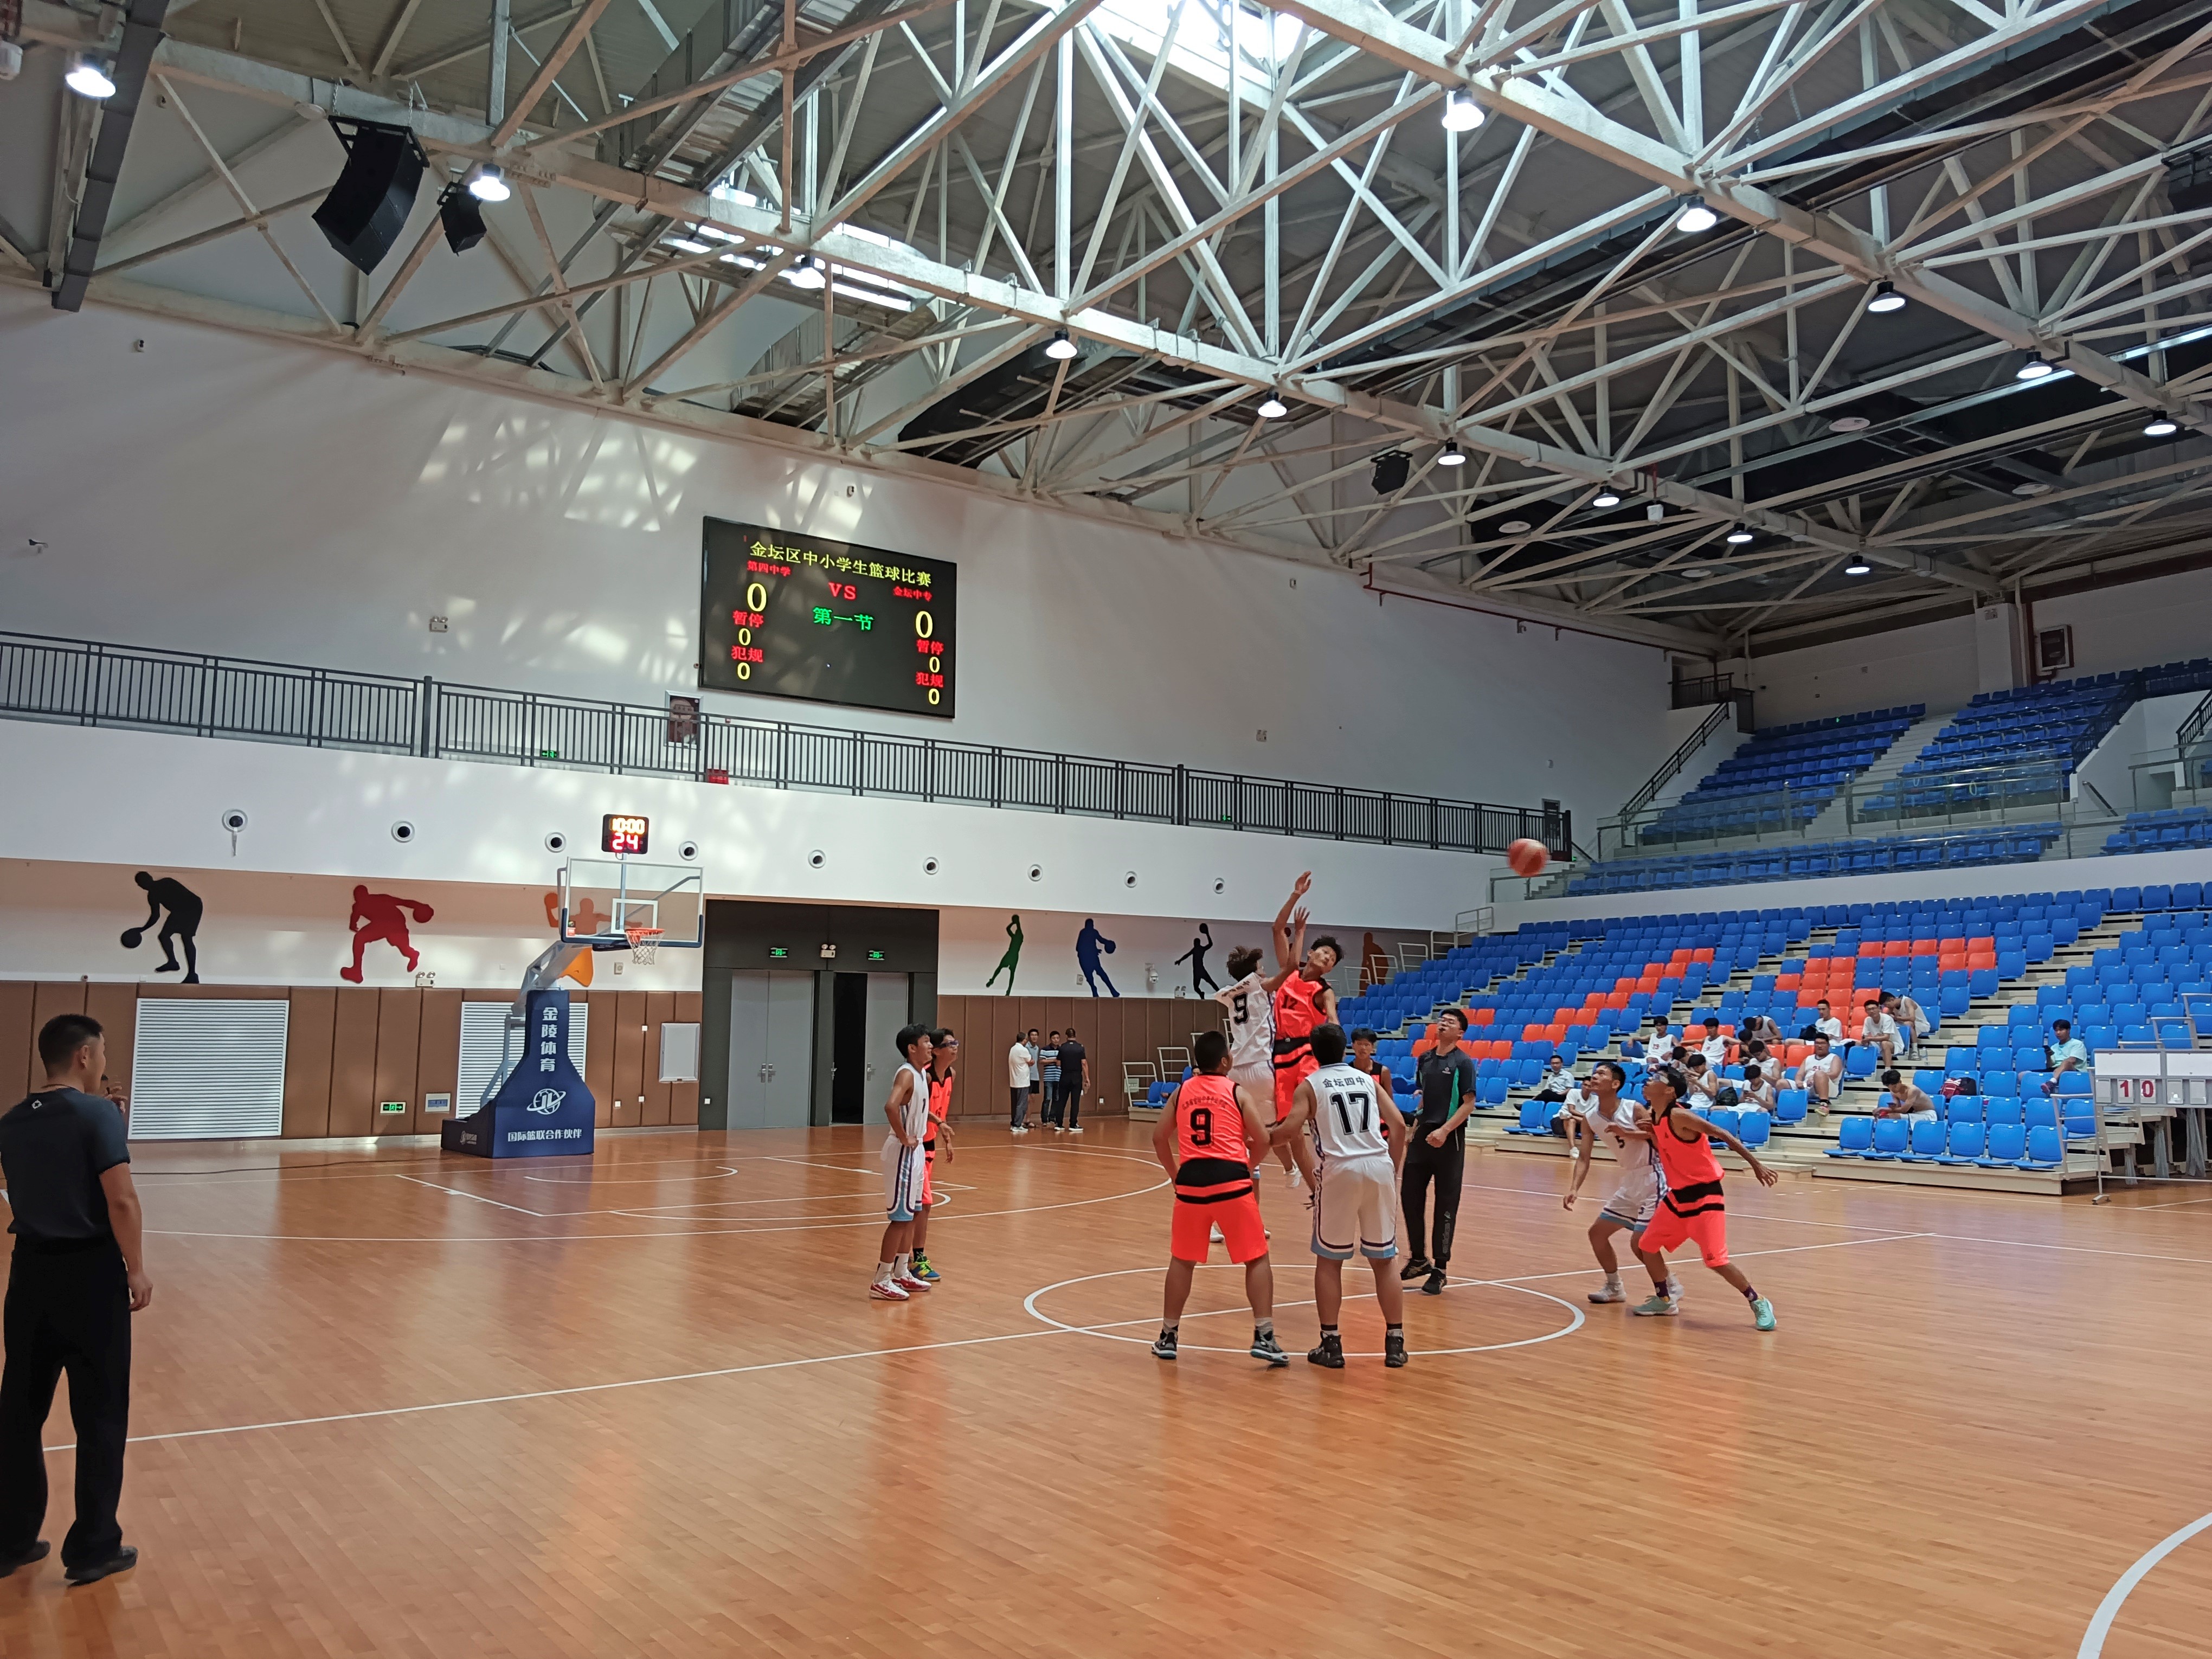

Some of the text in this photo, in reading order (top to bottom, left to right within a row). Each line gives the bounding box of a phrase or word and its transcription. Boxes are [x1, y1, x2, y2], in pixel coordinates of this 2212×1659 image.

[747, 560, 791, 577] 第四中学
[750, 541, 931, 587] 金坛区中小学生篮球比赛
[747, 583, 767, 612] 0
[829, 582, 857, 600] VS
[733, 610, 764, 628] 暂停
[813, 607, 874, 631] 第一节
[915, 610, 933, 638] 0
[738, 628, 751, 646] 0
[731, 646, 763, 663] 犯规
[916, 639, 944, 655] 暂停
[737, 662, 750, 680] 0
[929, 657, 940, 673] 0
[916, 672, 944, 688] 犯规
[929, 688, 940, 705] 0
[612, 818, 645, 834] 10:00
[613, 832, 638, 850] 24
[1233, 992, 1250, 1025] 9
[540, 1007, 558, 1072] 金陵体育
[1323, 1076, 1365, 1088] 金坛四中
[1329, 1091, 1371, 1135] 17
[507, 1128, 582, 1142] 国际篮联合作伙伴
[1190, 1108, 1214, 1148] 9
